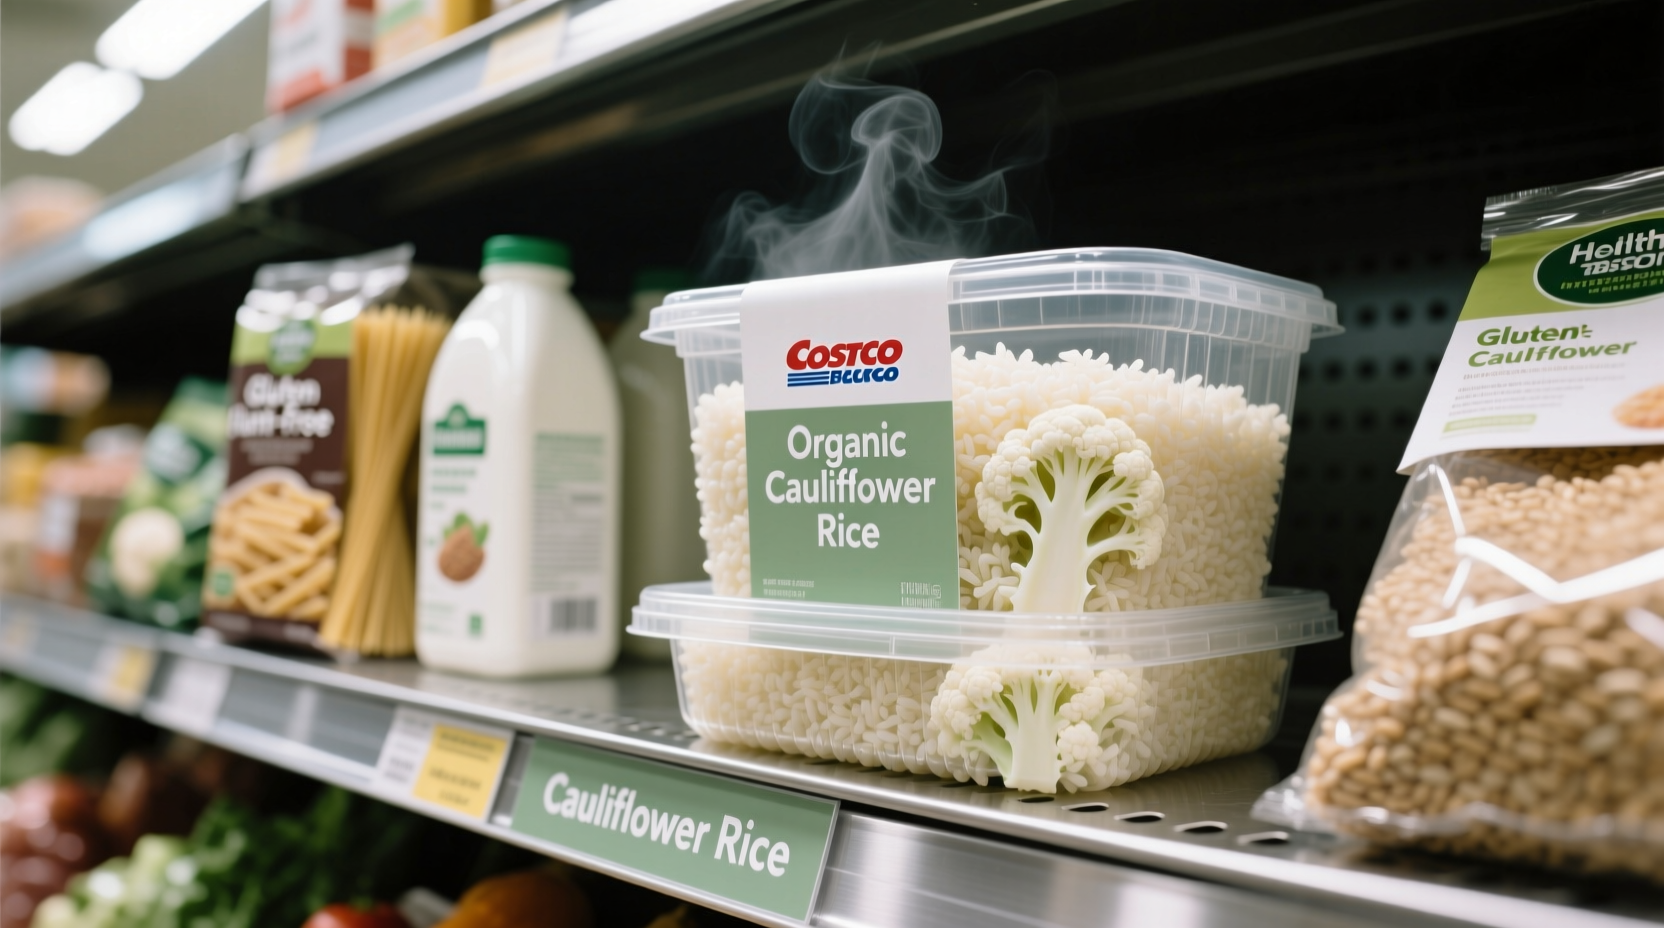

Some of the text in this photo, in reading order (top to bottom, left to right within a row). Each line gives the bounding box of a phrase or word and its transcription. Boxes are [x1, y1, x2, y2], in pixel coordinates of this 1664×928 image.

[786, 339, 903, 370] COSTCO
[787, 420, 906, 468] Organic
[818, 512, 880, 548] Rice
[543, 772, 790, 877] Cauliflower Rice
